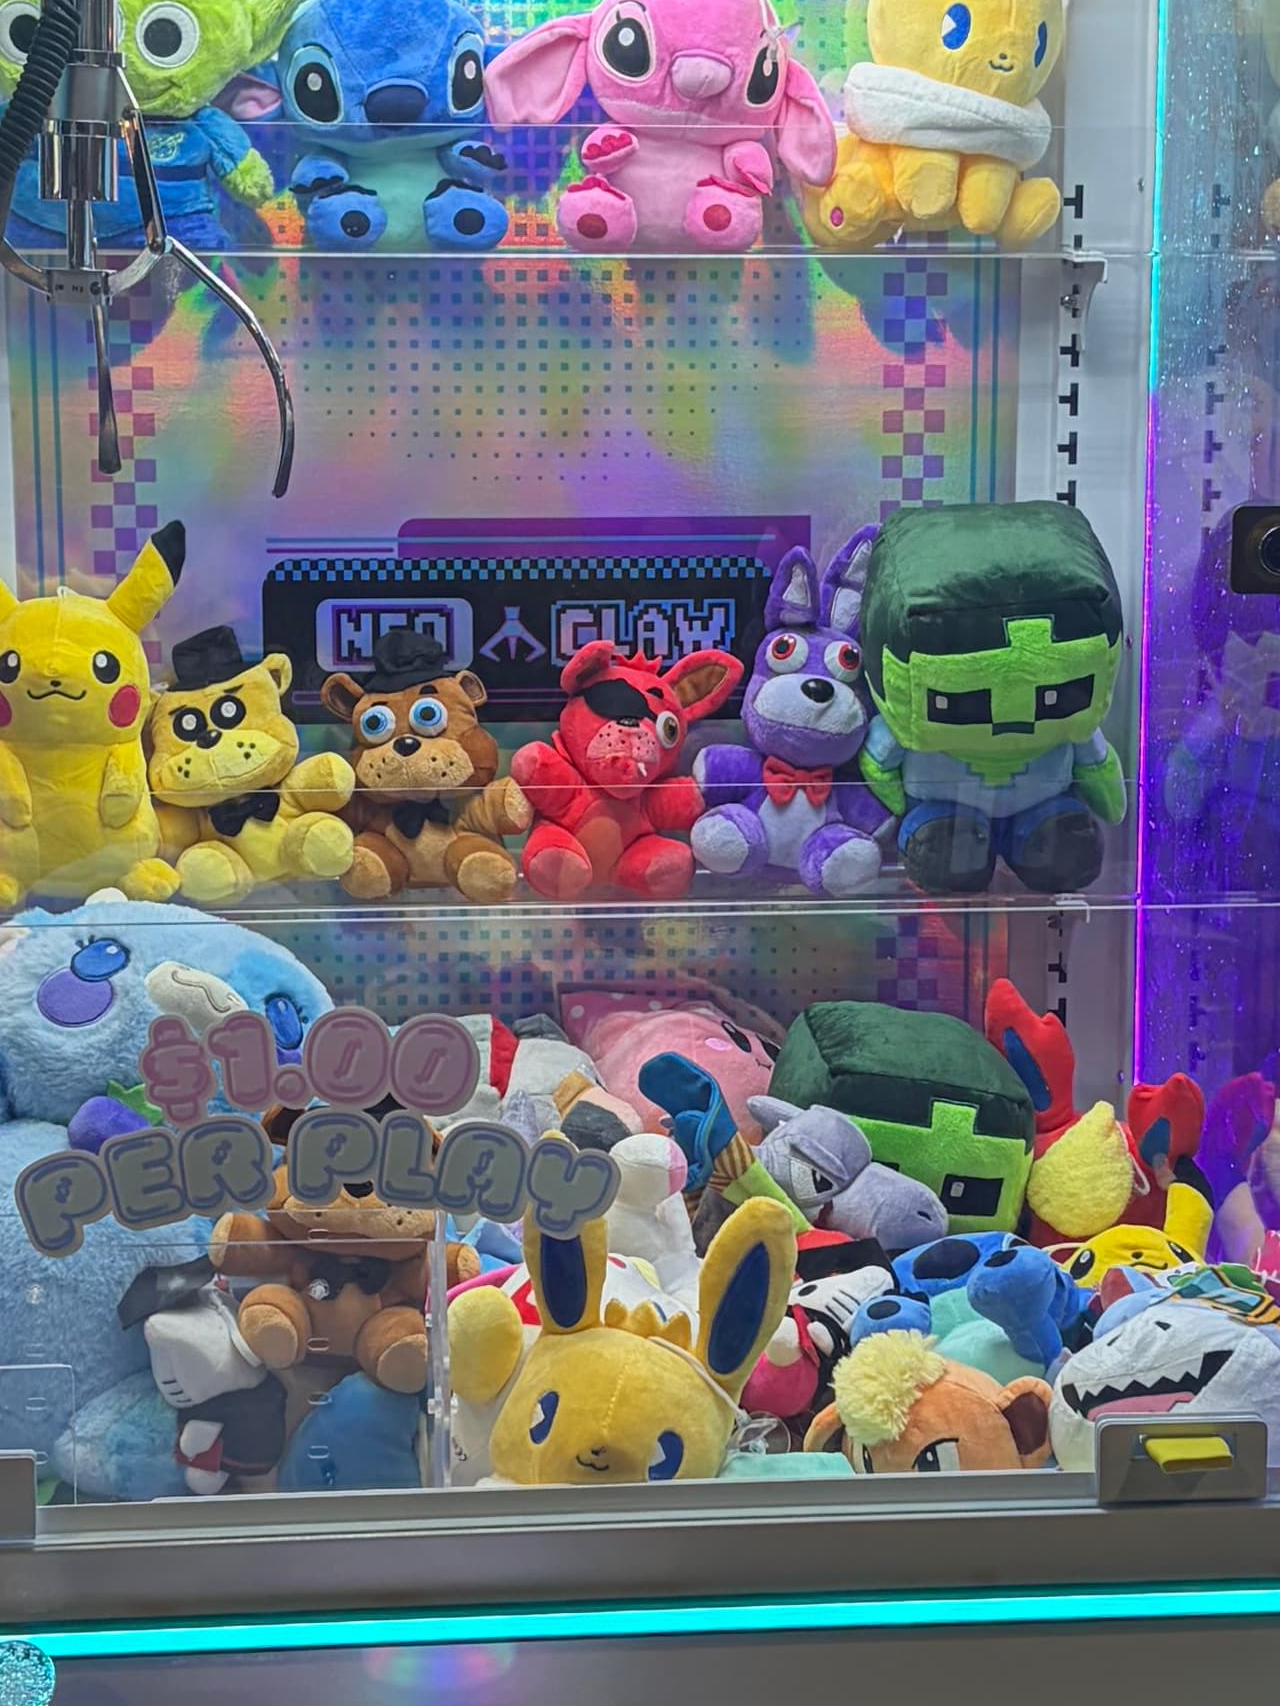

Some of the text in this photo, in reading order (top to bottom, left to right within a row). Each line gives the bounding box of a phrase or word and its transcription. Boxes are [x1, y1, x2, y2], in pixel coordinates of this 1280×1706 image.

[140, 1006, 480, 1127] $1.00
[15, 1107, 621, 1257] PER PLAY
